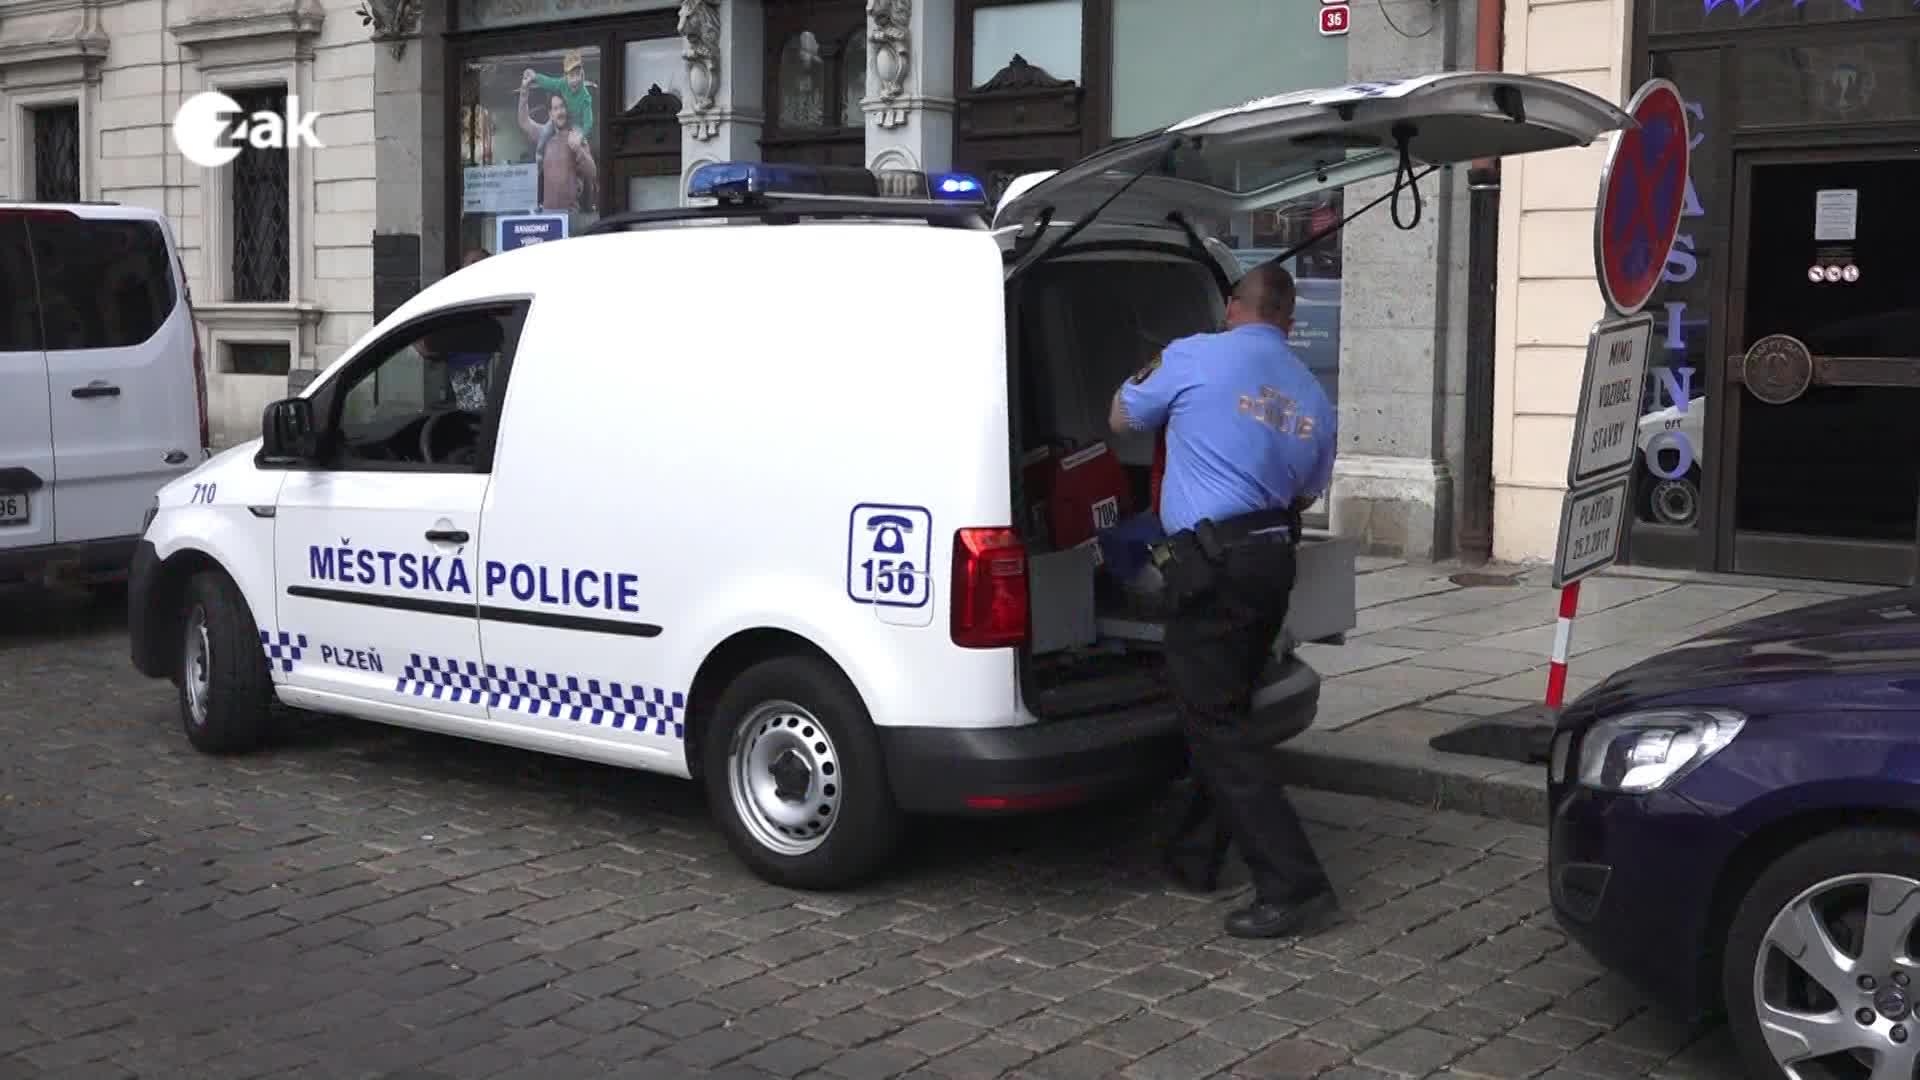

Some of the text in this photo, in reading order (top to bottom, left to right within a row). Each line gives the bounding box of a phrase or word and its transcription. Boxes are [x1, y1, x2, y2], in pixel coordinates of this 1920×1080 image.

[1327, 12, 1342, 26] 36
[1608, 340, 1633, 366] MIMO
[1599, 378, 1633, 408] VOZIDEL
[1591, 421, 1625, 453] STAVBY
[191, 483, 217, 505] 710
[309, 537, 640, 612] MĚSTSKÁ POLICIE
[861, 558, 915, 596] 156
[320, 643, 384, 673] PLZEŇ
